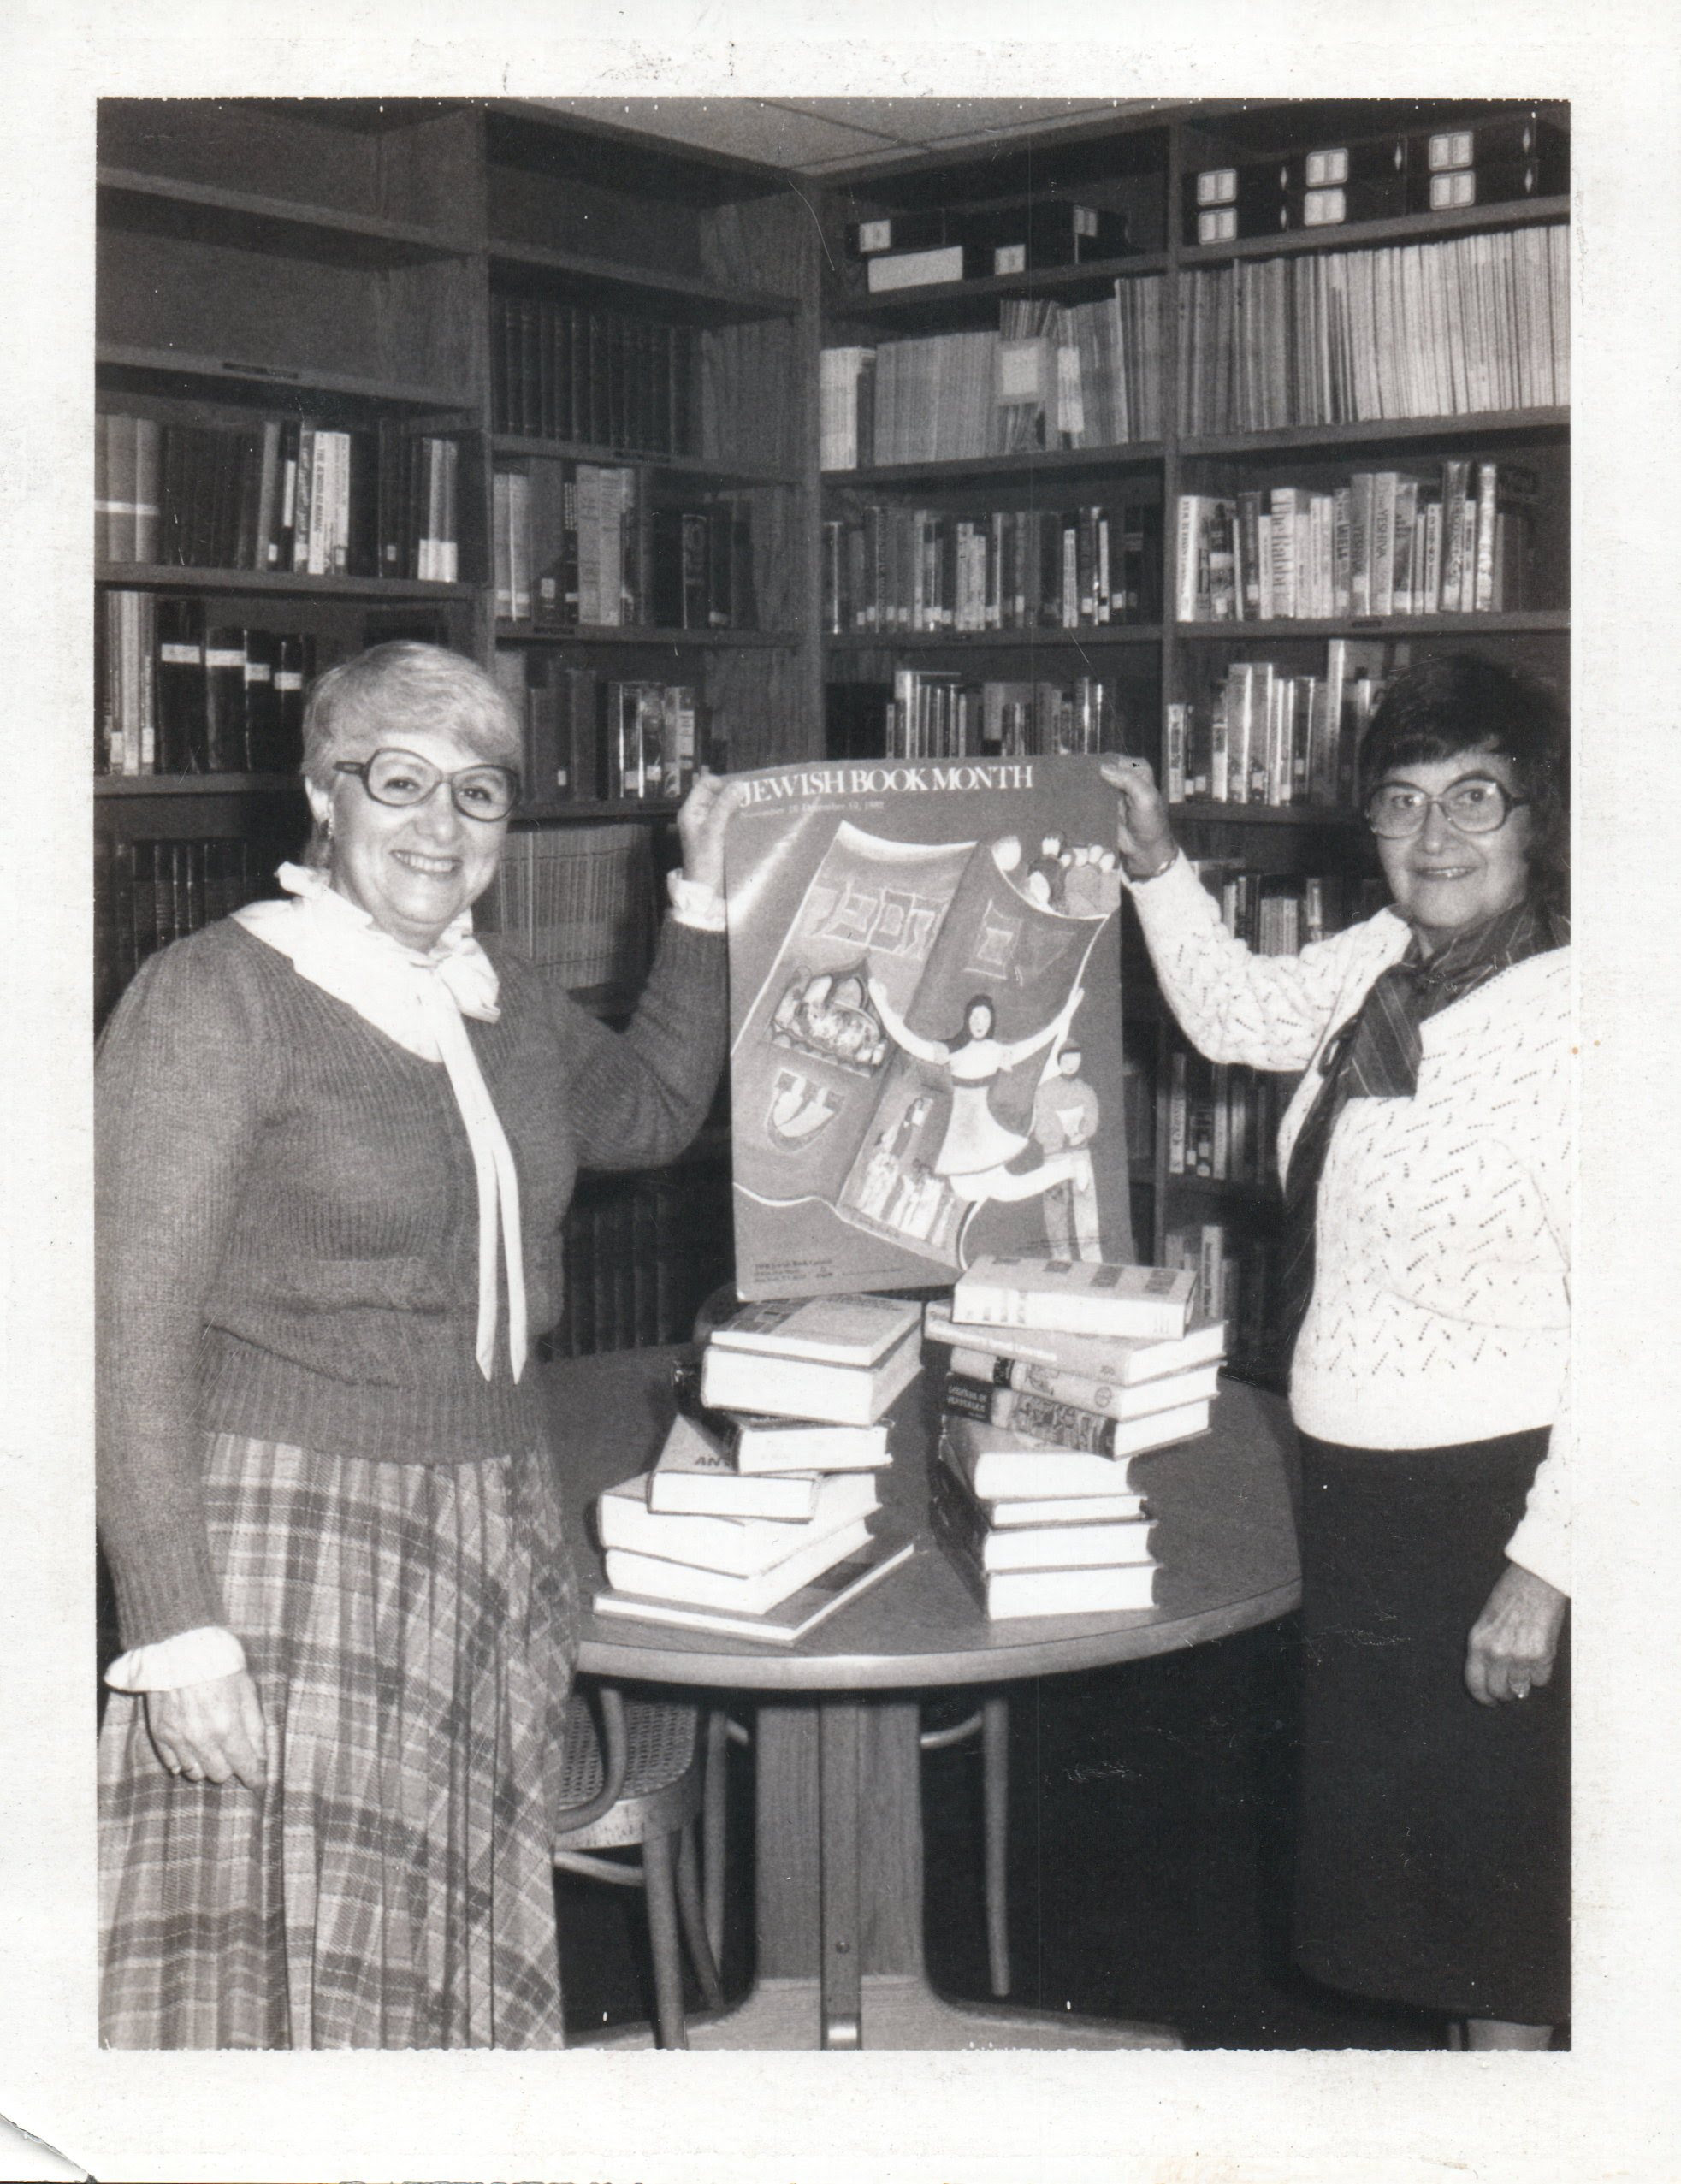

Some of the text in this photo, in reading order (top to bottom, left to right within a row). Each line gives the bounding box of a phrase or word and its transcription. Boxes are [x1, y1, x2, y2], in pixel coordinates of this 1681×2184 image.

[1376, 509, 1388, 560] YESHIVA
[741, 765, 1033, 807] JEWISH BOOK MONTH
